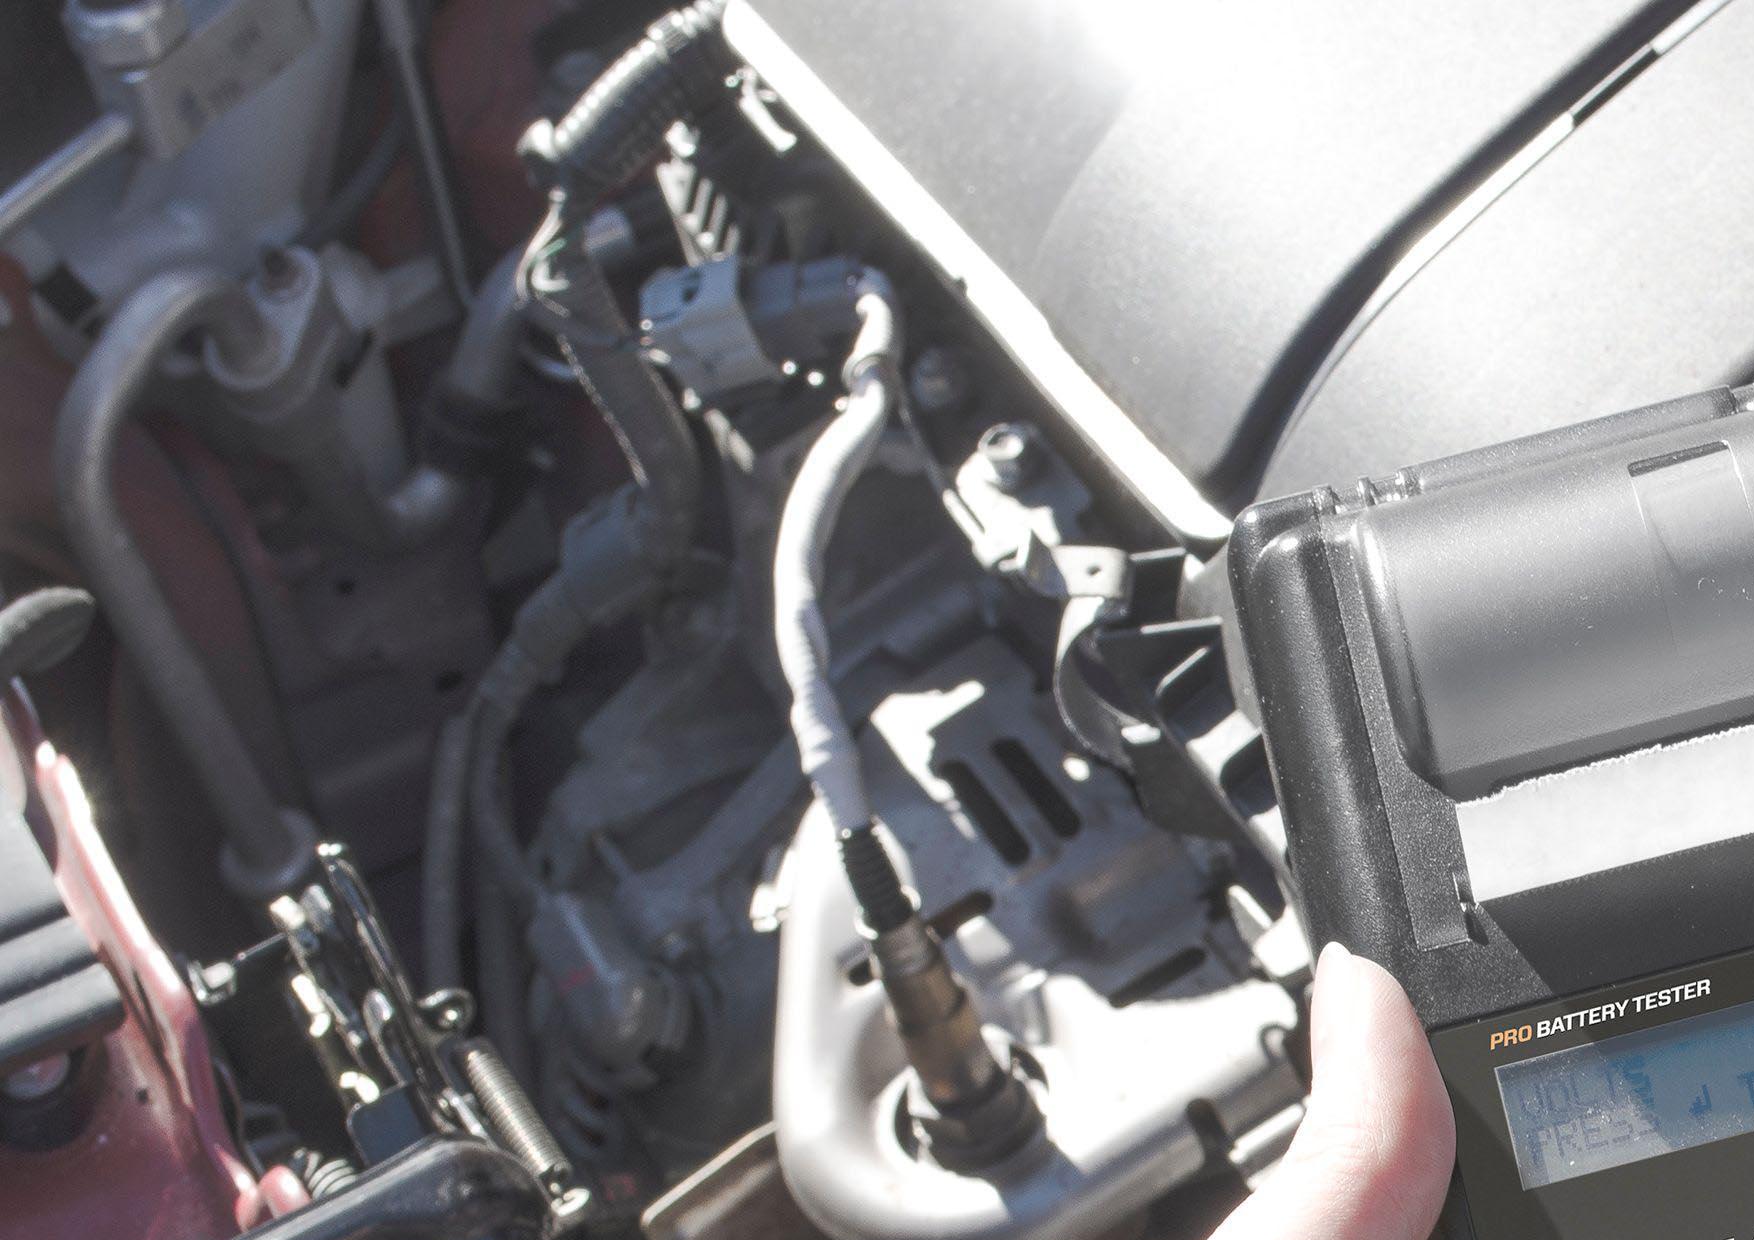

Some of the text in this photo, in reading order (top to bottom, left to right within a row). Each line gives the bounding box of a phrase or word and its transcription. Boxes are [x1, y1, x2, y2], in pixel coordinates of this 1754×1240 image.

[1490, 978, 1711, 1050] PRO BATTERY TESTER
